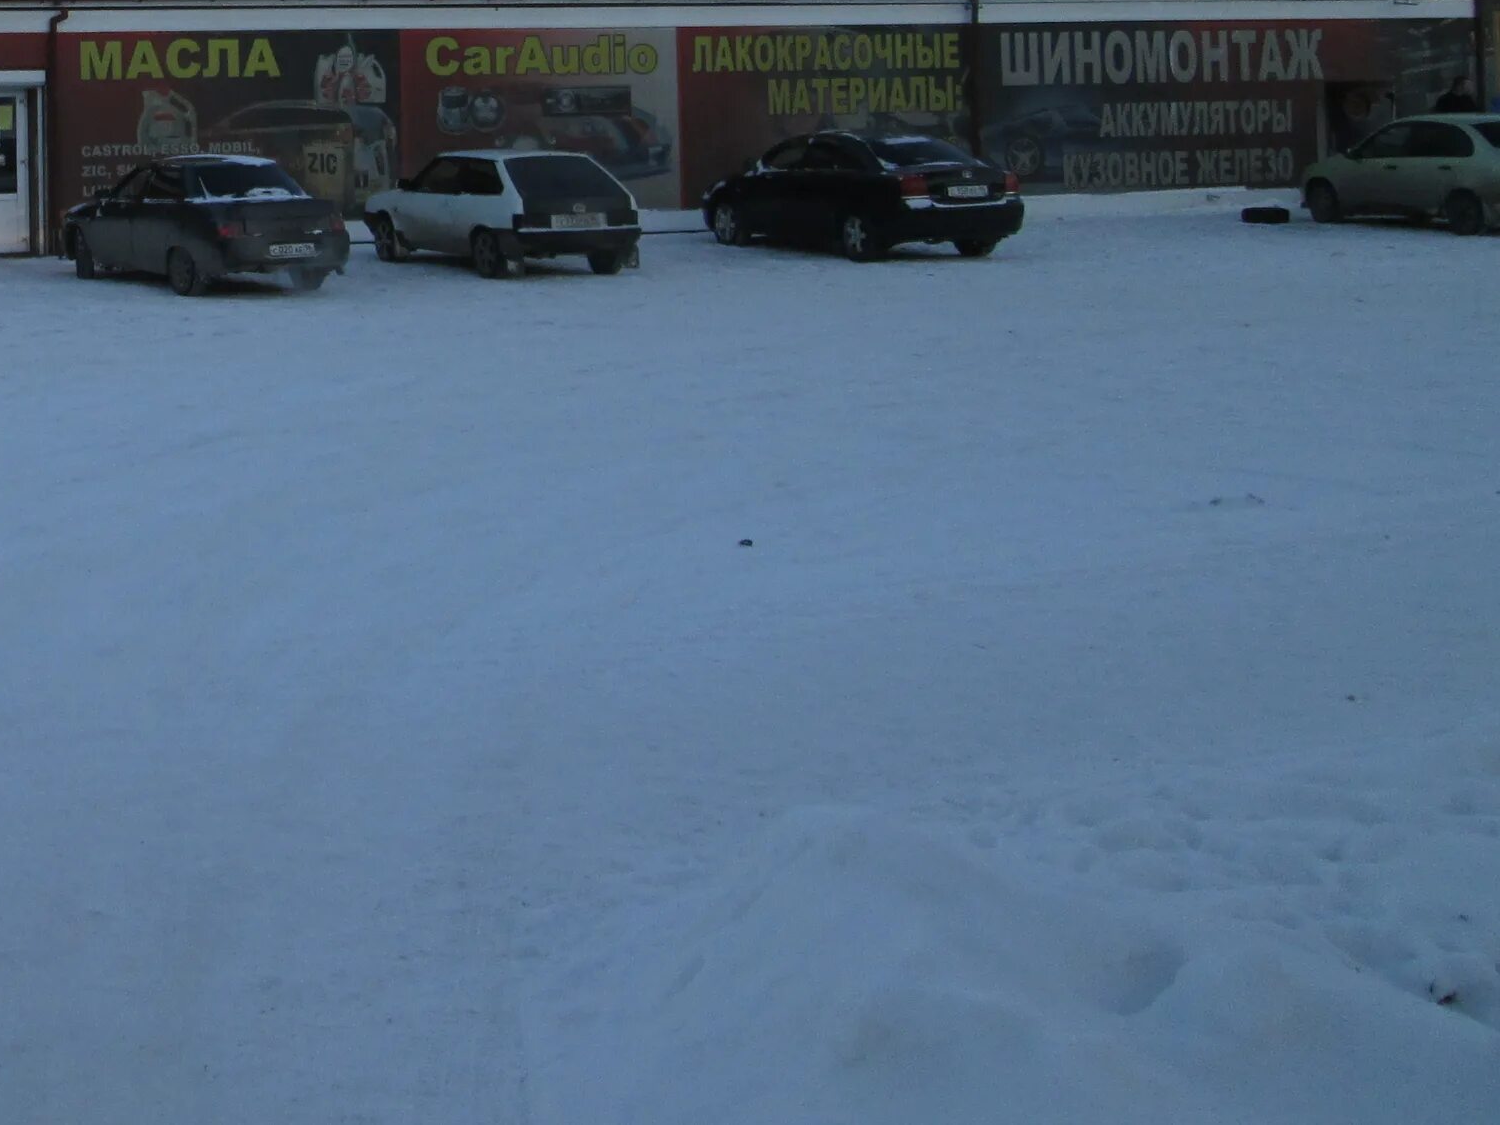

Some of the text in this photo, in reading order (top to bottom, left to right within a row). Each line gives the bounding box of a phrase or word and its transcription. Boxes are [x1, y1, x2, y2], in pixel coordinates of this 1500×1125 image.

[79, 38, 281, 80] МАСЛА
[425, 34, 658, 76] CarAudio
[692, 32, 960, 73] ЛАКОКРАСОЧНЫЕ
[1000, 28, 1325, 87] ШИНОМОНТАЖ
[1100, 98, 1293, 139] АККУМУЛЯТОРЫ
[81, 143, 156, 157] CASTROL,
[307, 152, 338, 175] ZIC
[1062, 146, 1294, 190] КУЗОВНОЕ ЖЕЛЕЗО
